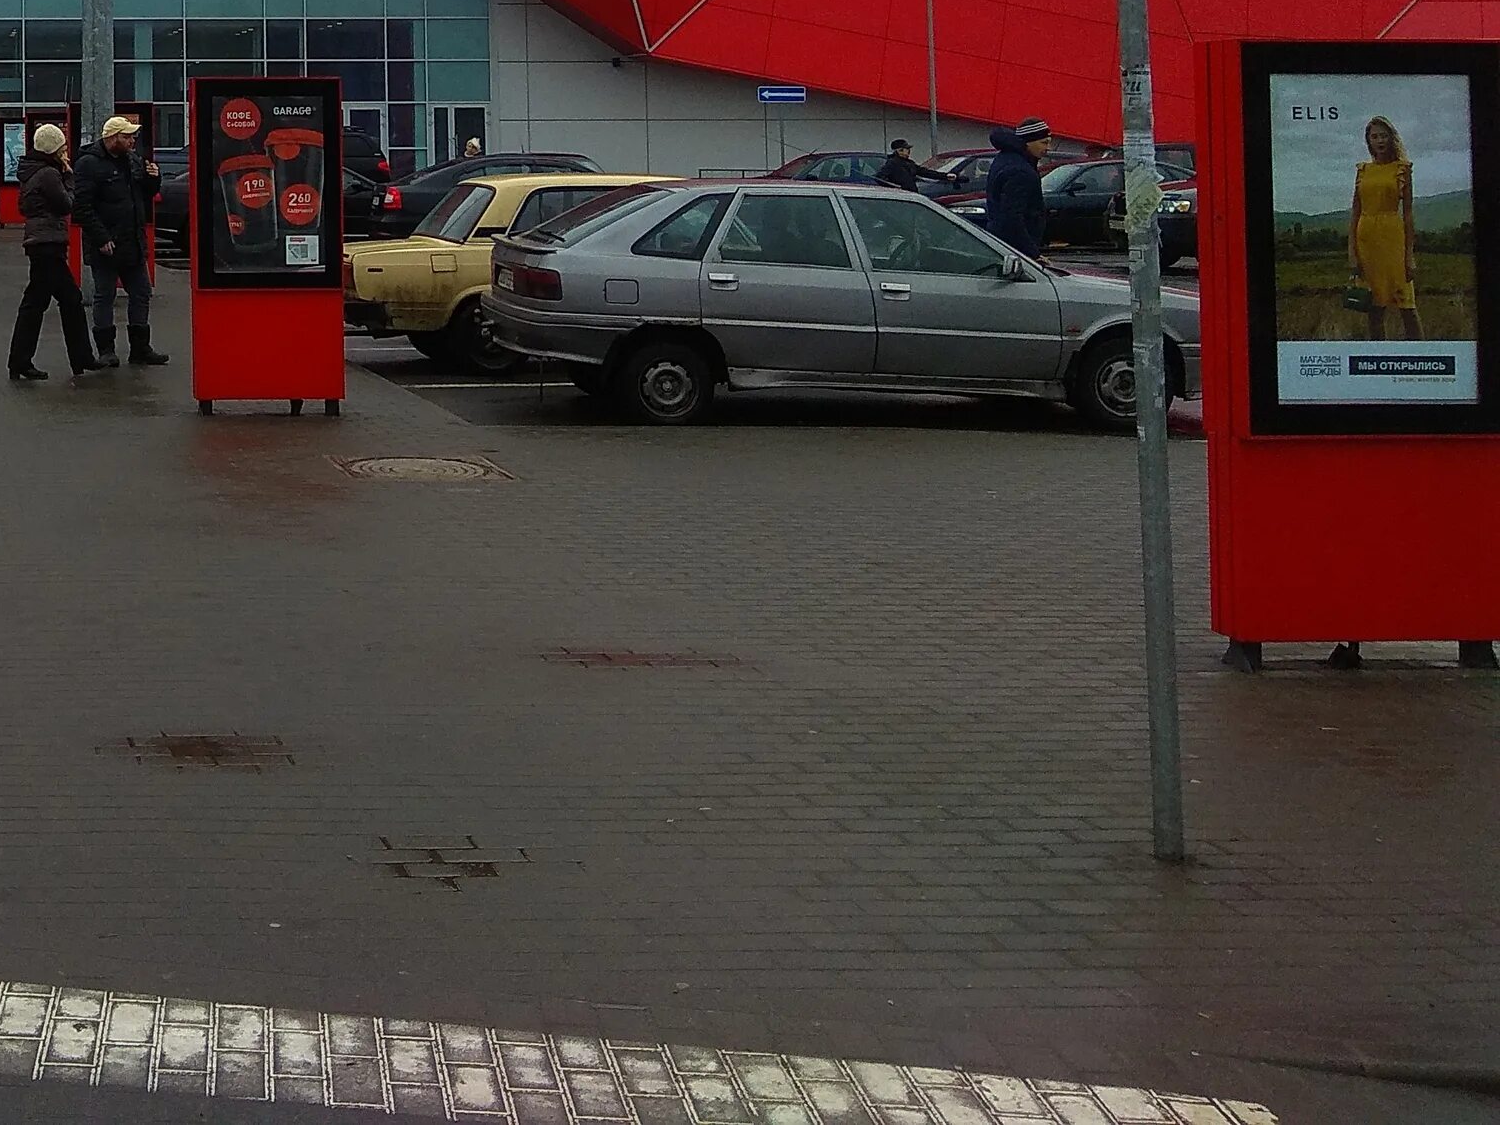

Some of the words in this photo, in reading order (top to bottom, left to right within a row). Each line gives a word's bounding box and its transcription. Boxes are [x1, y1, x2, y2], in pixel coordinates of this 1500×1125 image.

[226, 111, 251, 120] КОФЕ
[1292, 106, 1340, 120] ELIS
[1300, 355, 1342, 364] МАГАЗИН
[1358, 361, 1377, 371] МЫ
[1379, 361, 1446, 371] ОТКРЫЛИСЬ
[1300, 368, 1342, 377] ОДЕЖДЫ
